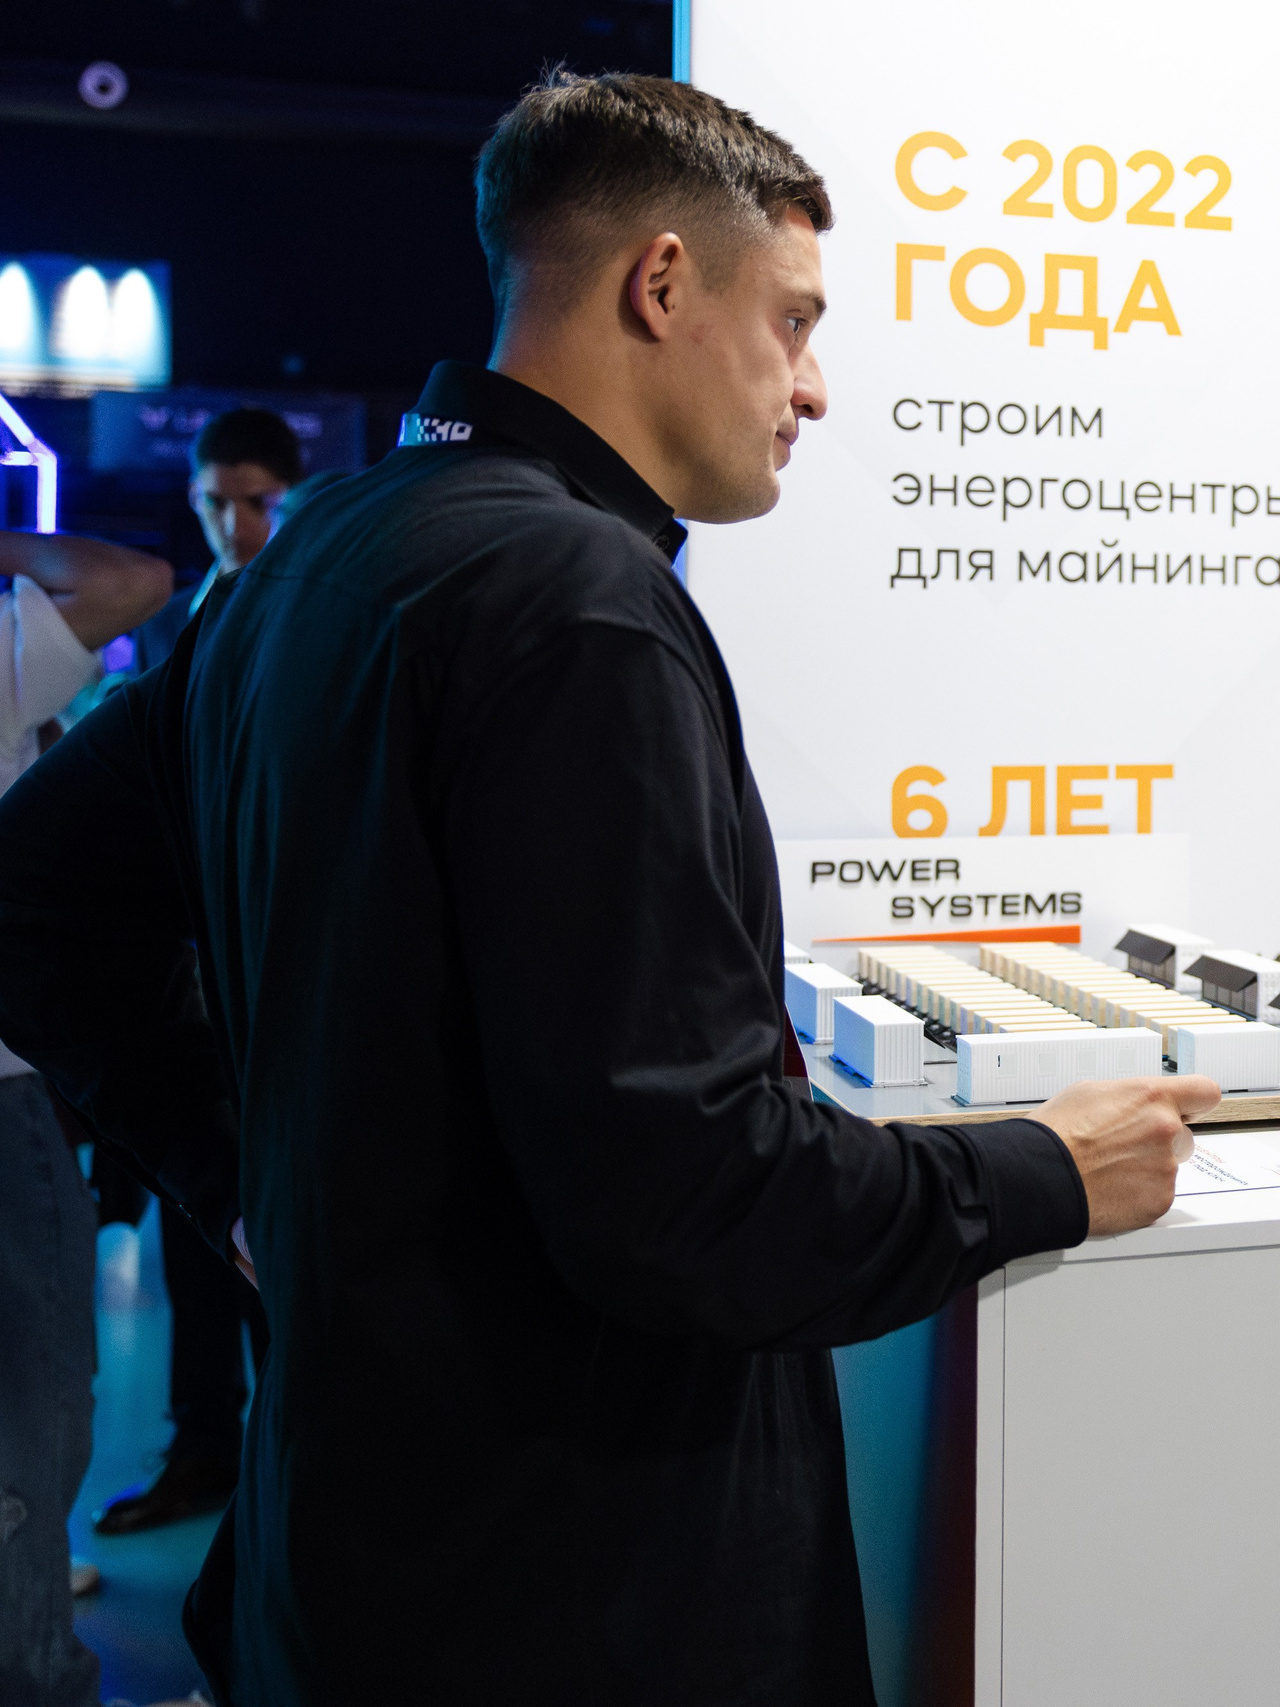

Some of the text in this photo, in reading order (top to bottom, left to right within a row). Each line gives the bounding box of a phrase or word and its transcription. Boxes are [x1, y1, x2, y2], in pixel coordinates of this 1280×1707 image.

[895, 131, 1232, 232] С 2022
[895, 243, 1183, 351] ГОДА
[892, 398, 1104, 447] строим
[890, 547, 996, 590] для
[891, 764, 1175, 838] 6 ЛЕТ
[810, 858, 961, 884] POWER
[891, 892, 1082, 919] SYSTEMS
